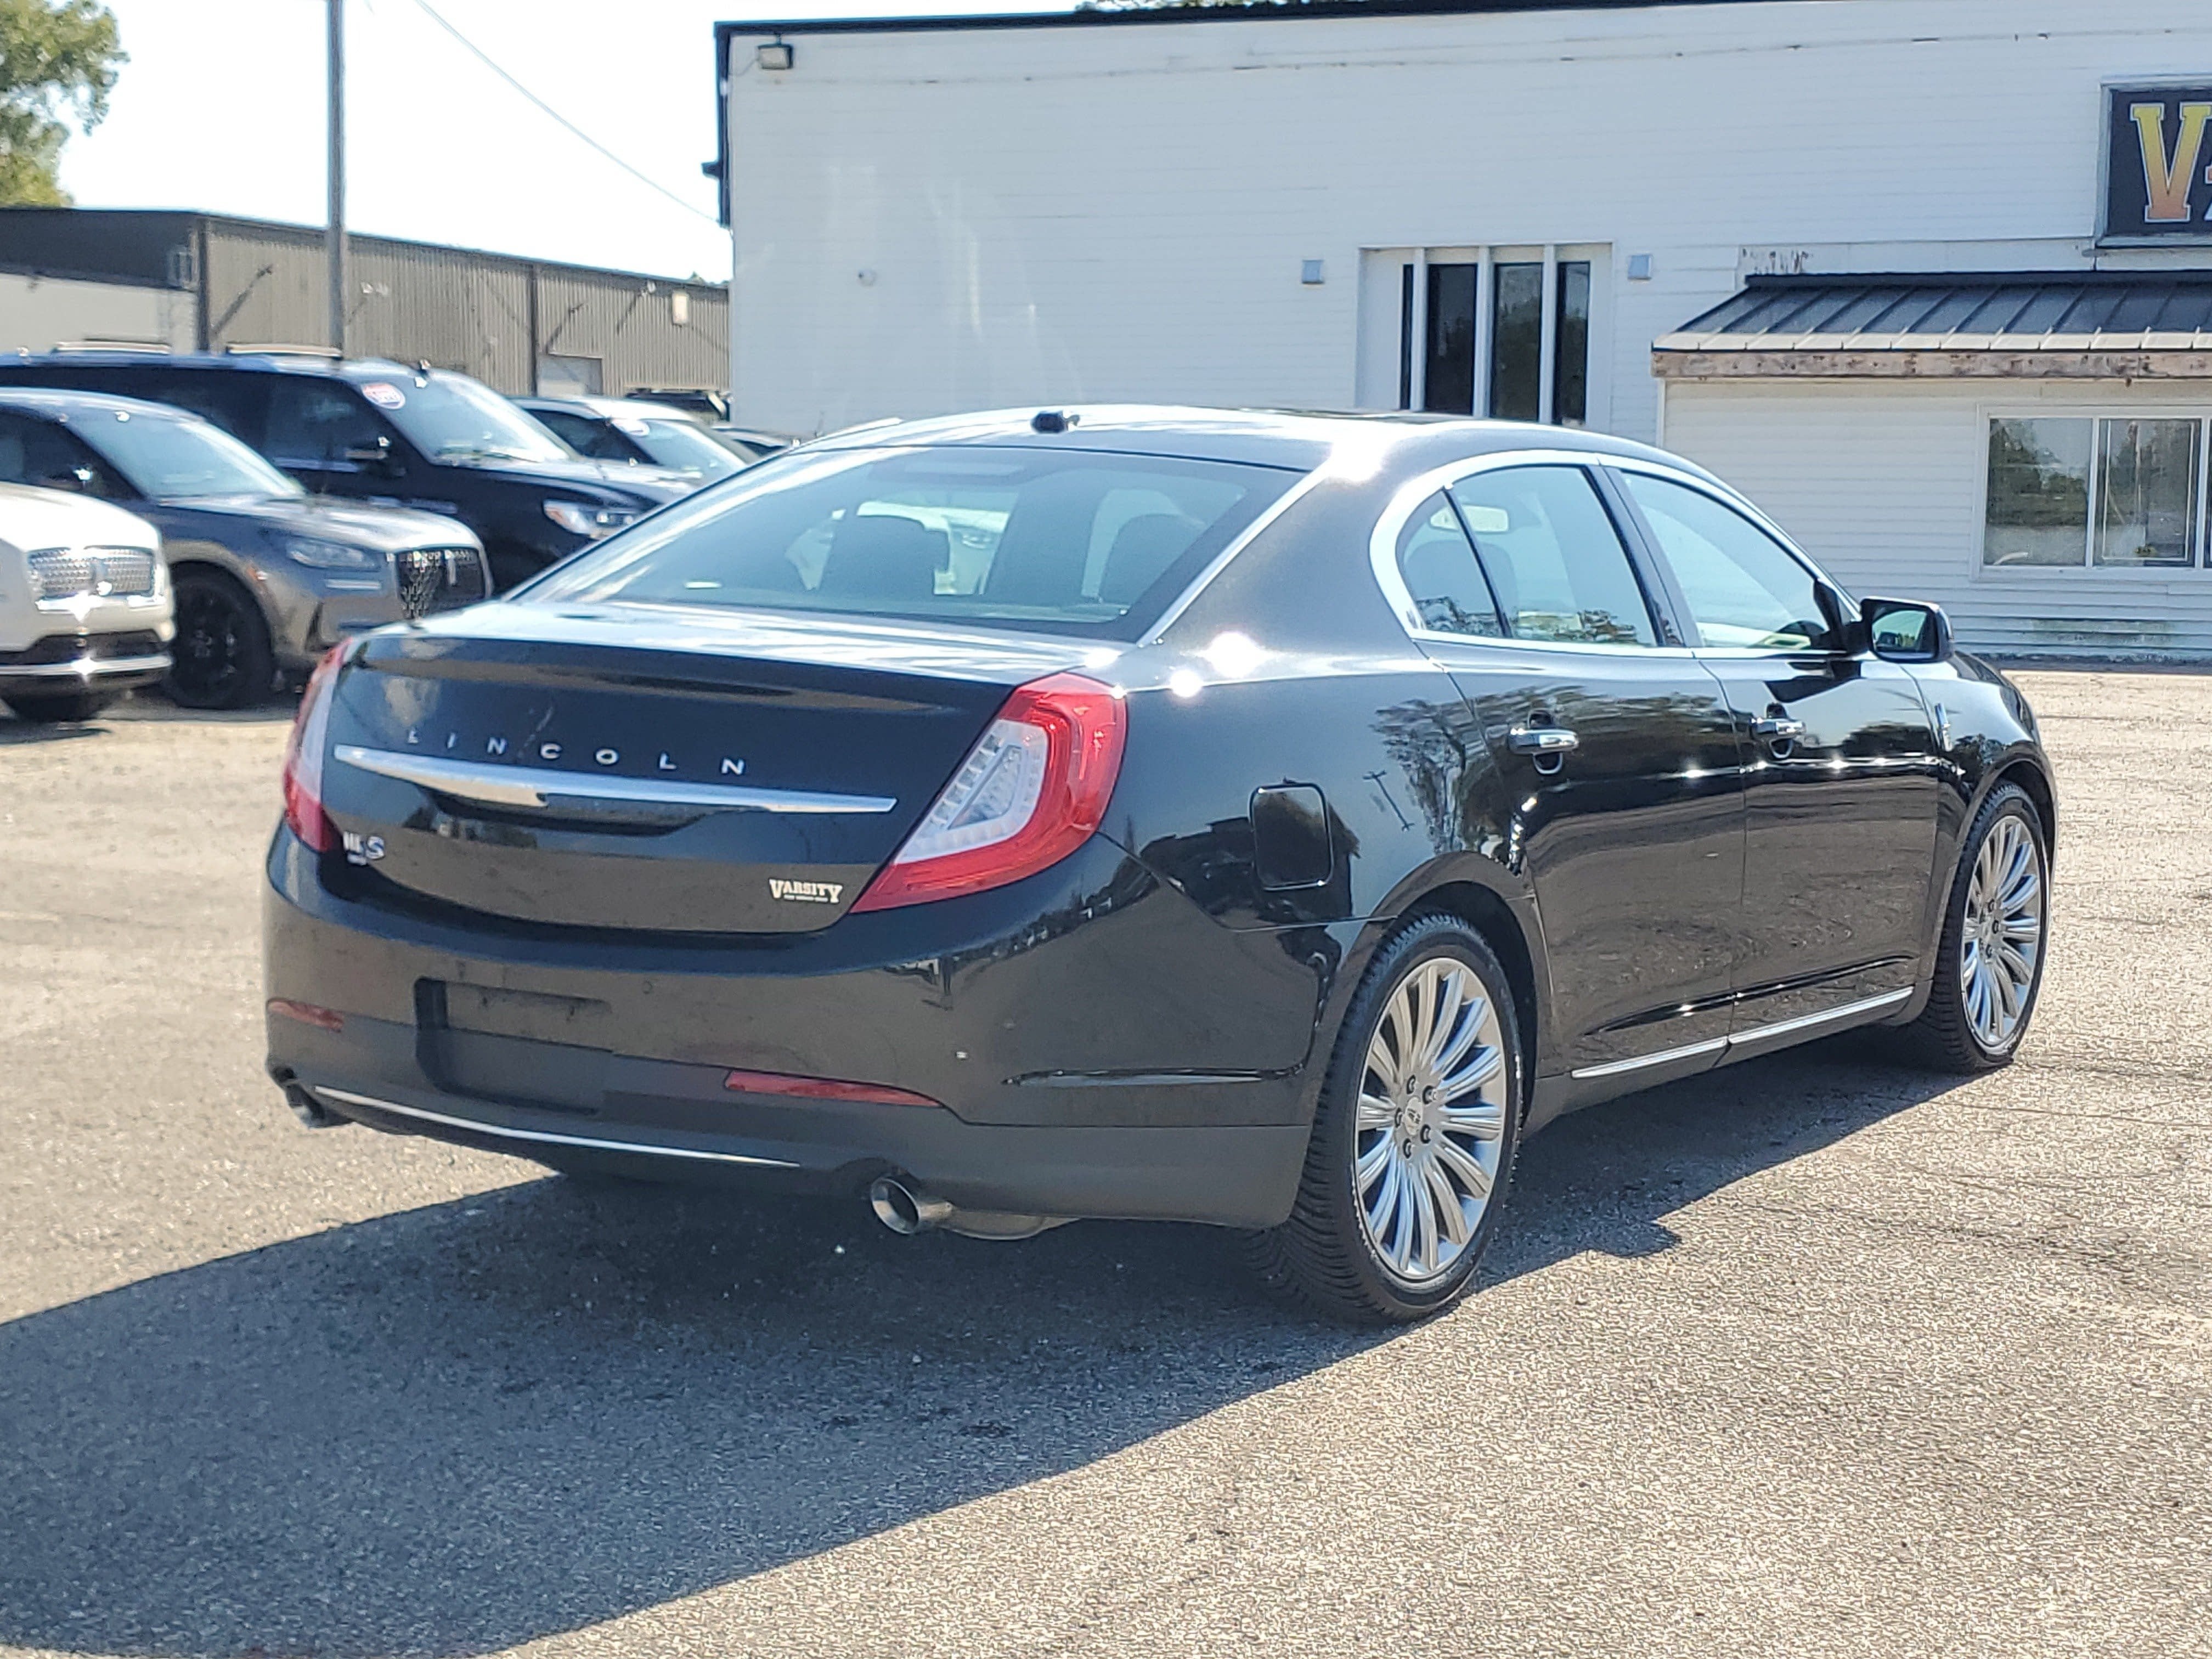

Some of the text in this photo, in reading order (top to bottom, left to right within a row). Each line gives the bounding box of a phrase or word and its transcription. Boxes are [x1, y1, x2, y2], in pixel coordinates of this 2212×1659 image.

[2130, 102, 2212, 222] V
[408, 729, 744, 775] LINCOLN
[769, 879, 843, 903] VARSITY
